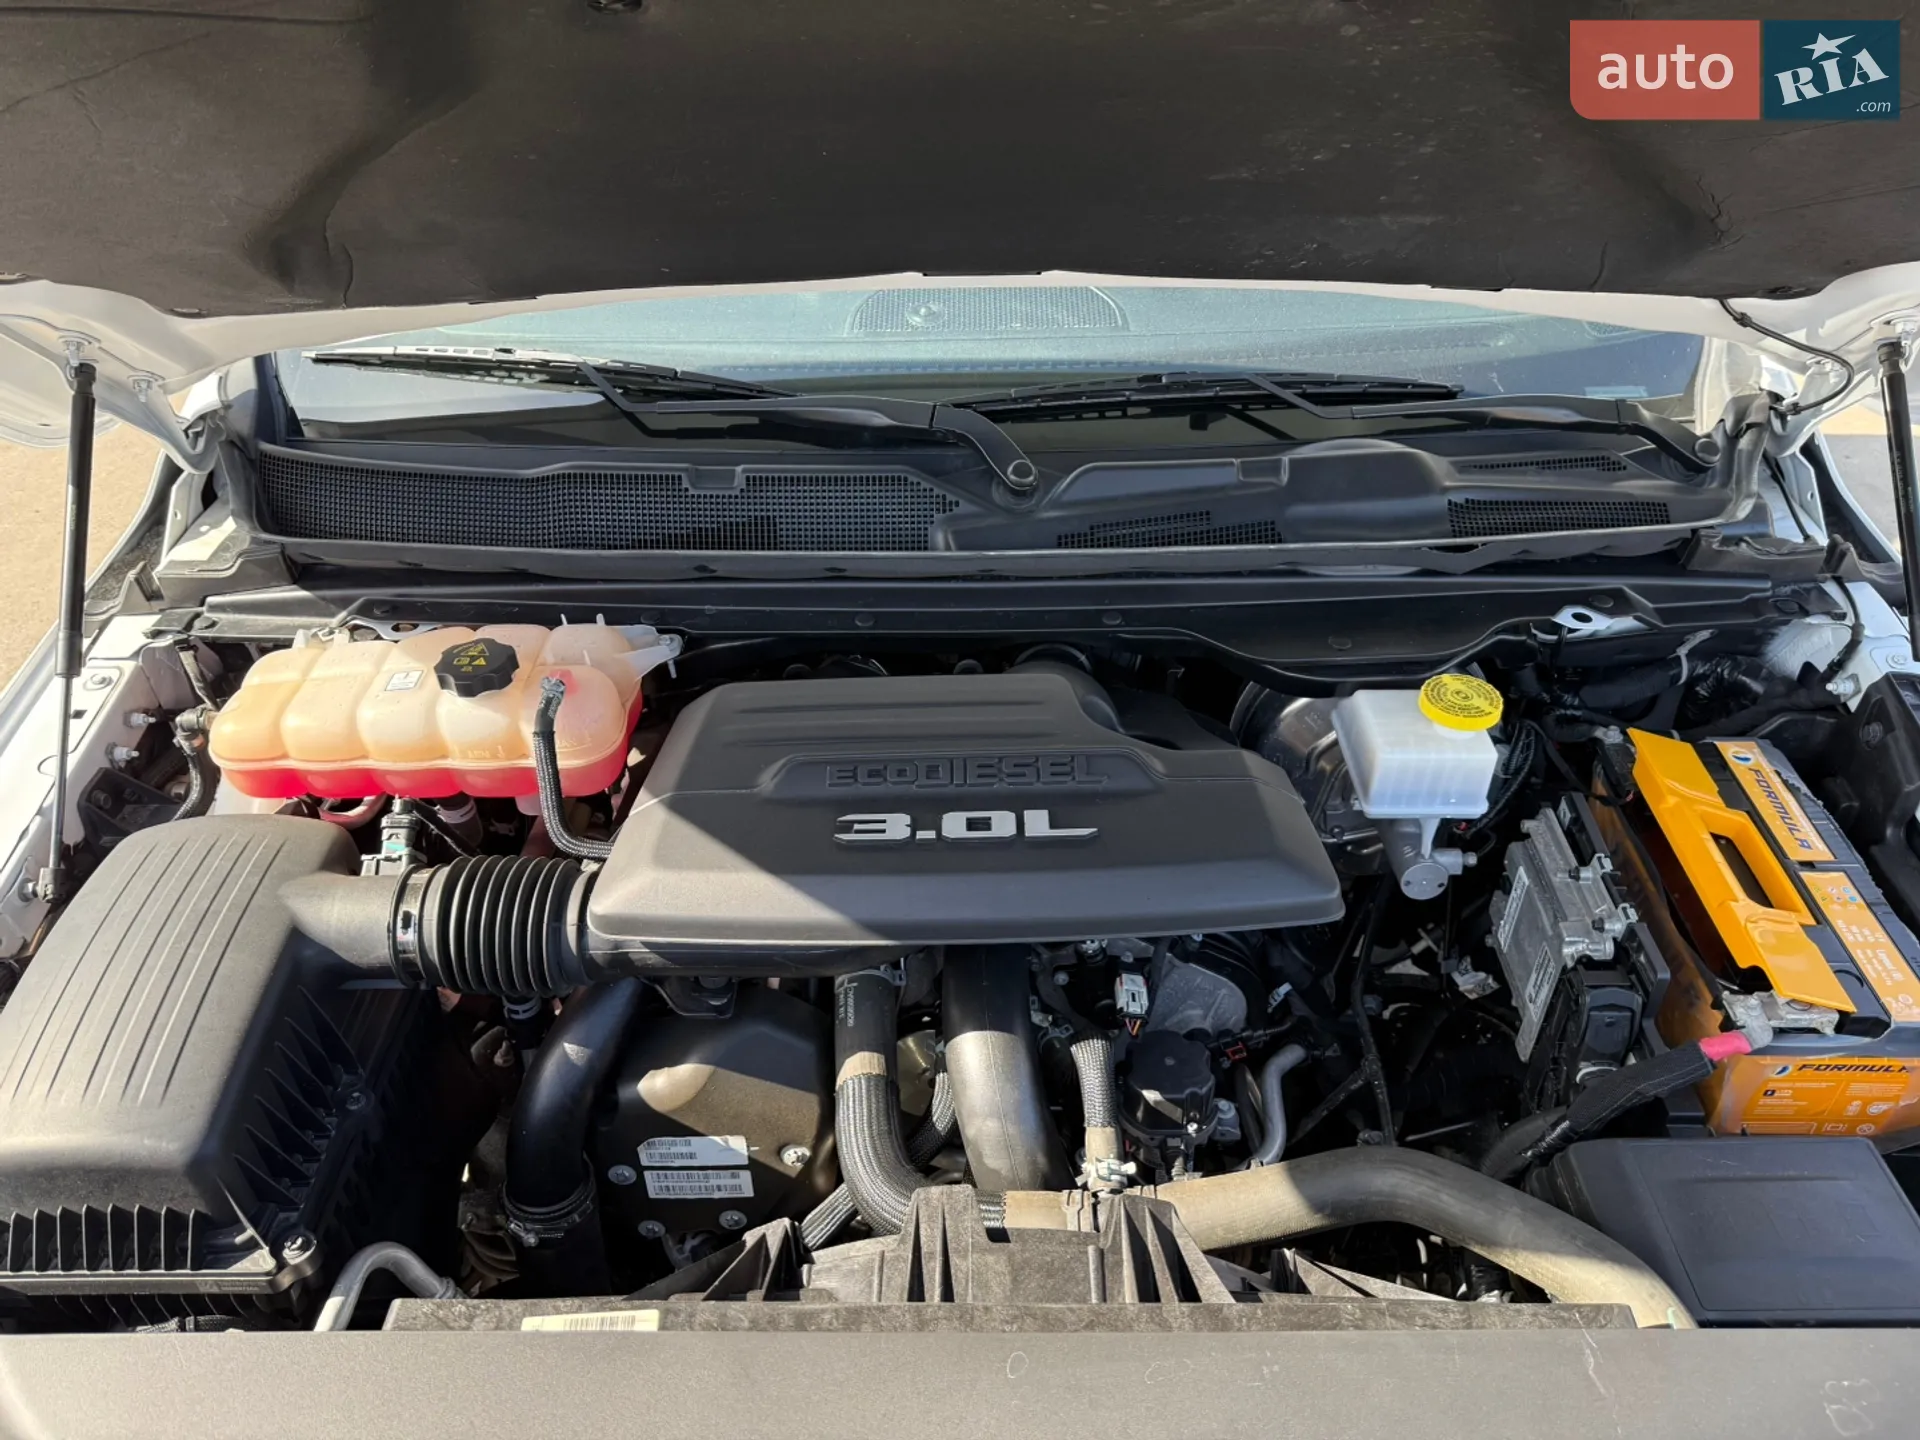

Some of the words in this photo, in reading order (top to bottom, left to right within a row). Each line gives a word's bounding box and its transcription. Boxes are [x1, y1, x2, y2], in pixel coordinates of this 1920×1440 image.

[826, 755, 1109, 789] ECODIESEL
[1748, 767, 1813, 850] FORMULA
[833, 809, 1099, 844] 3.0L
